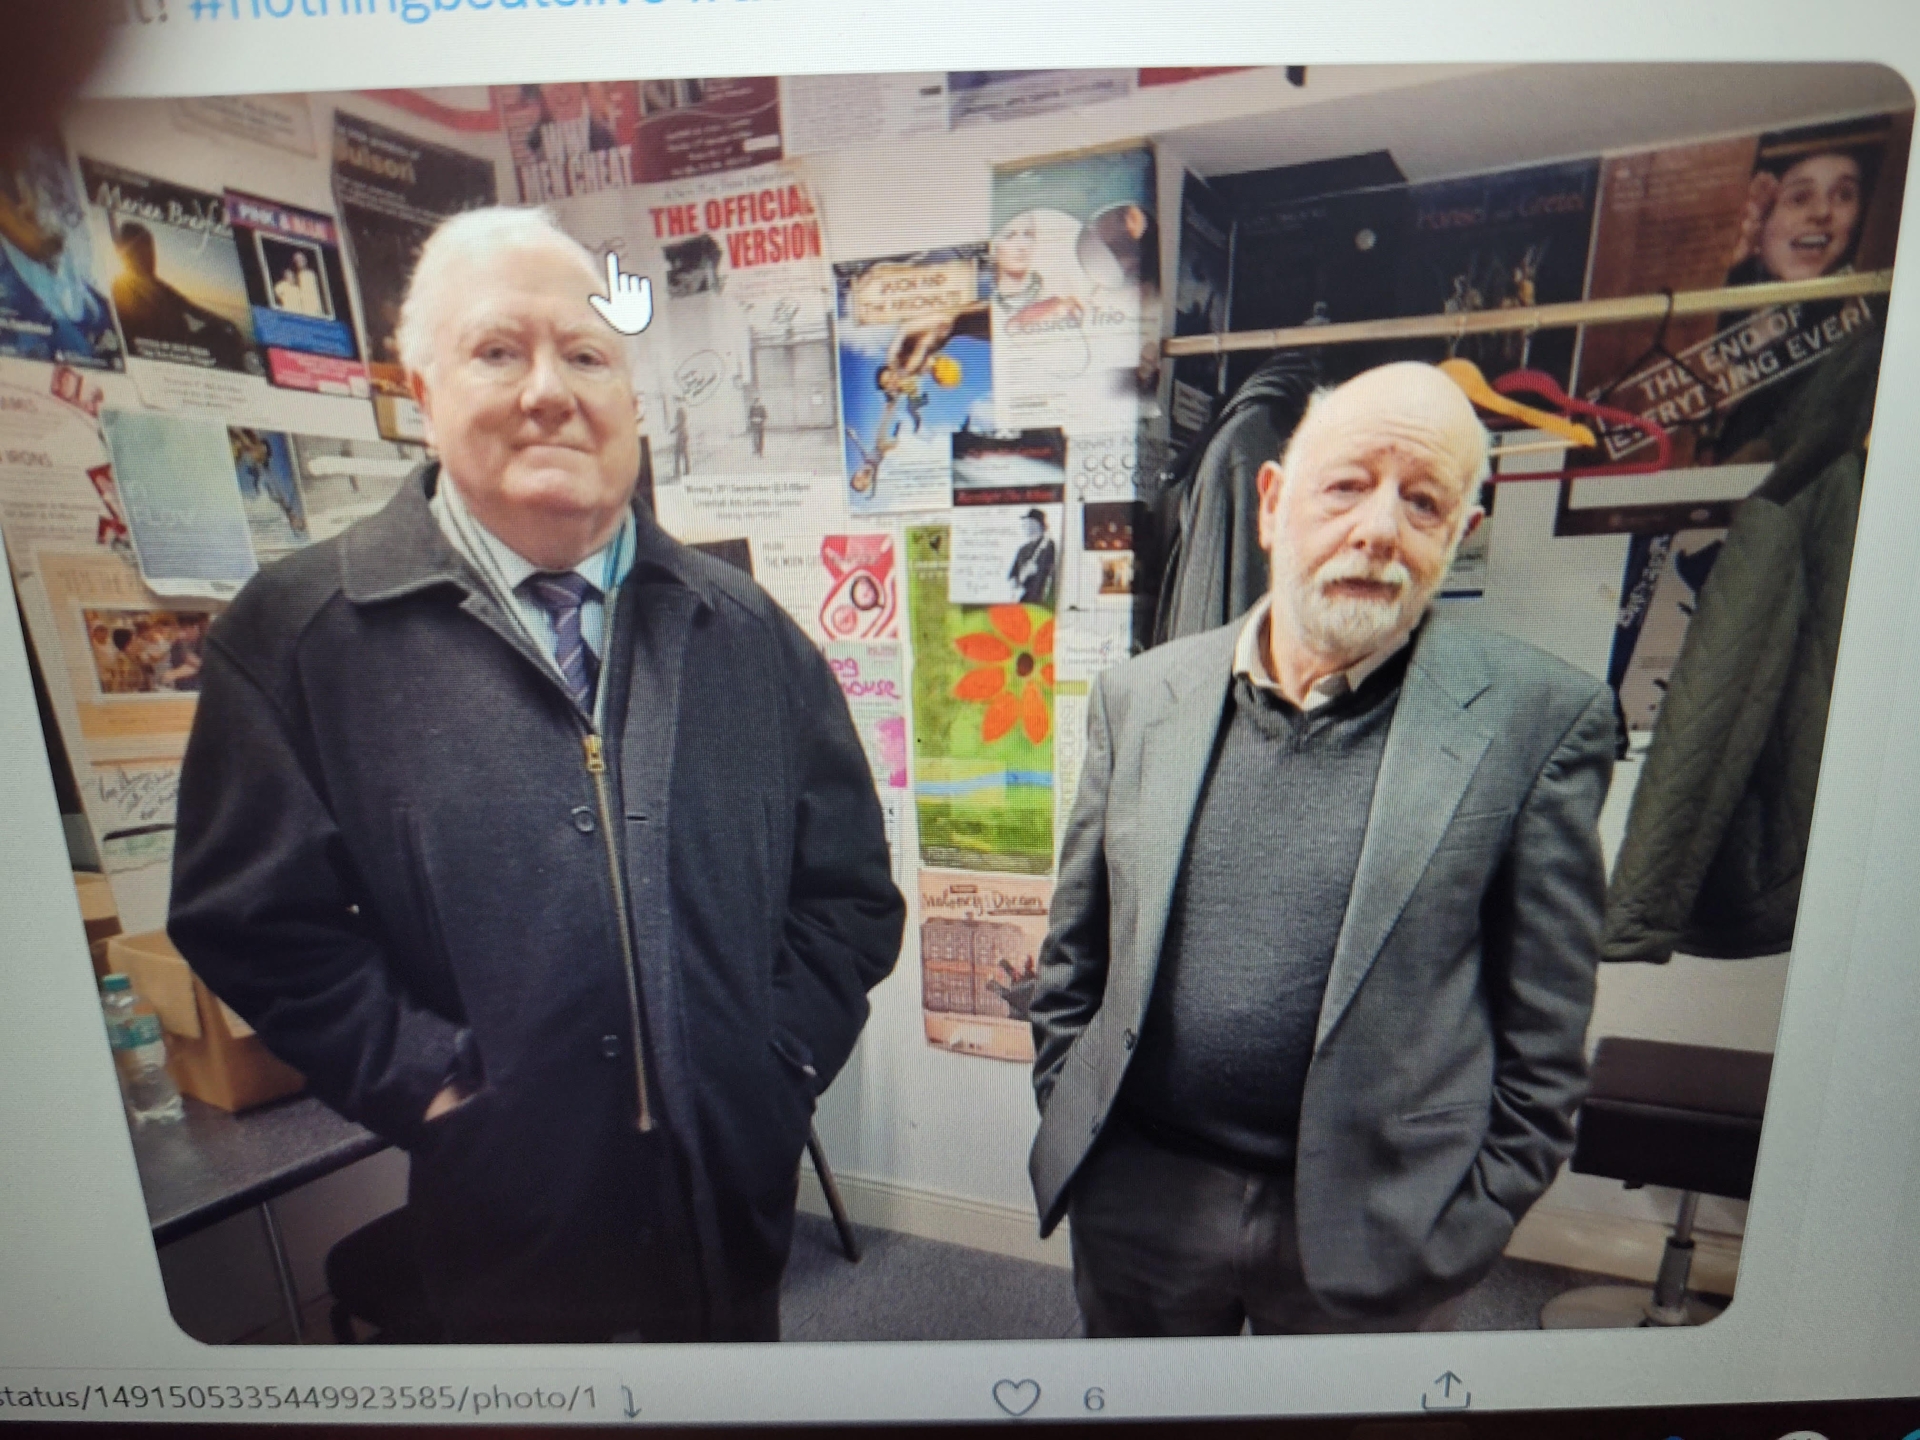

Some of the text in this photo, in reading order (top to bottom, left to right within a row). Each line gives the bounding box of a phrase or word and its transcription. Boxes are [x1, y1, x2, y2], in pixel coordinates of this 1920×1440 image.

[649, 203, 699, 239] THE
[727, 219, 822, 269] VERSION
[1786, 295, 1873, 359] EVER!
[1639, 304, 1802, 402] THE END OF
[828, 657, 859, 678] og
[1084, 1386, 1105, 1411] 6
